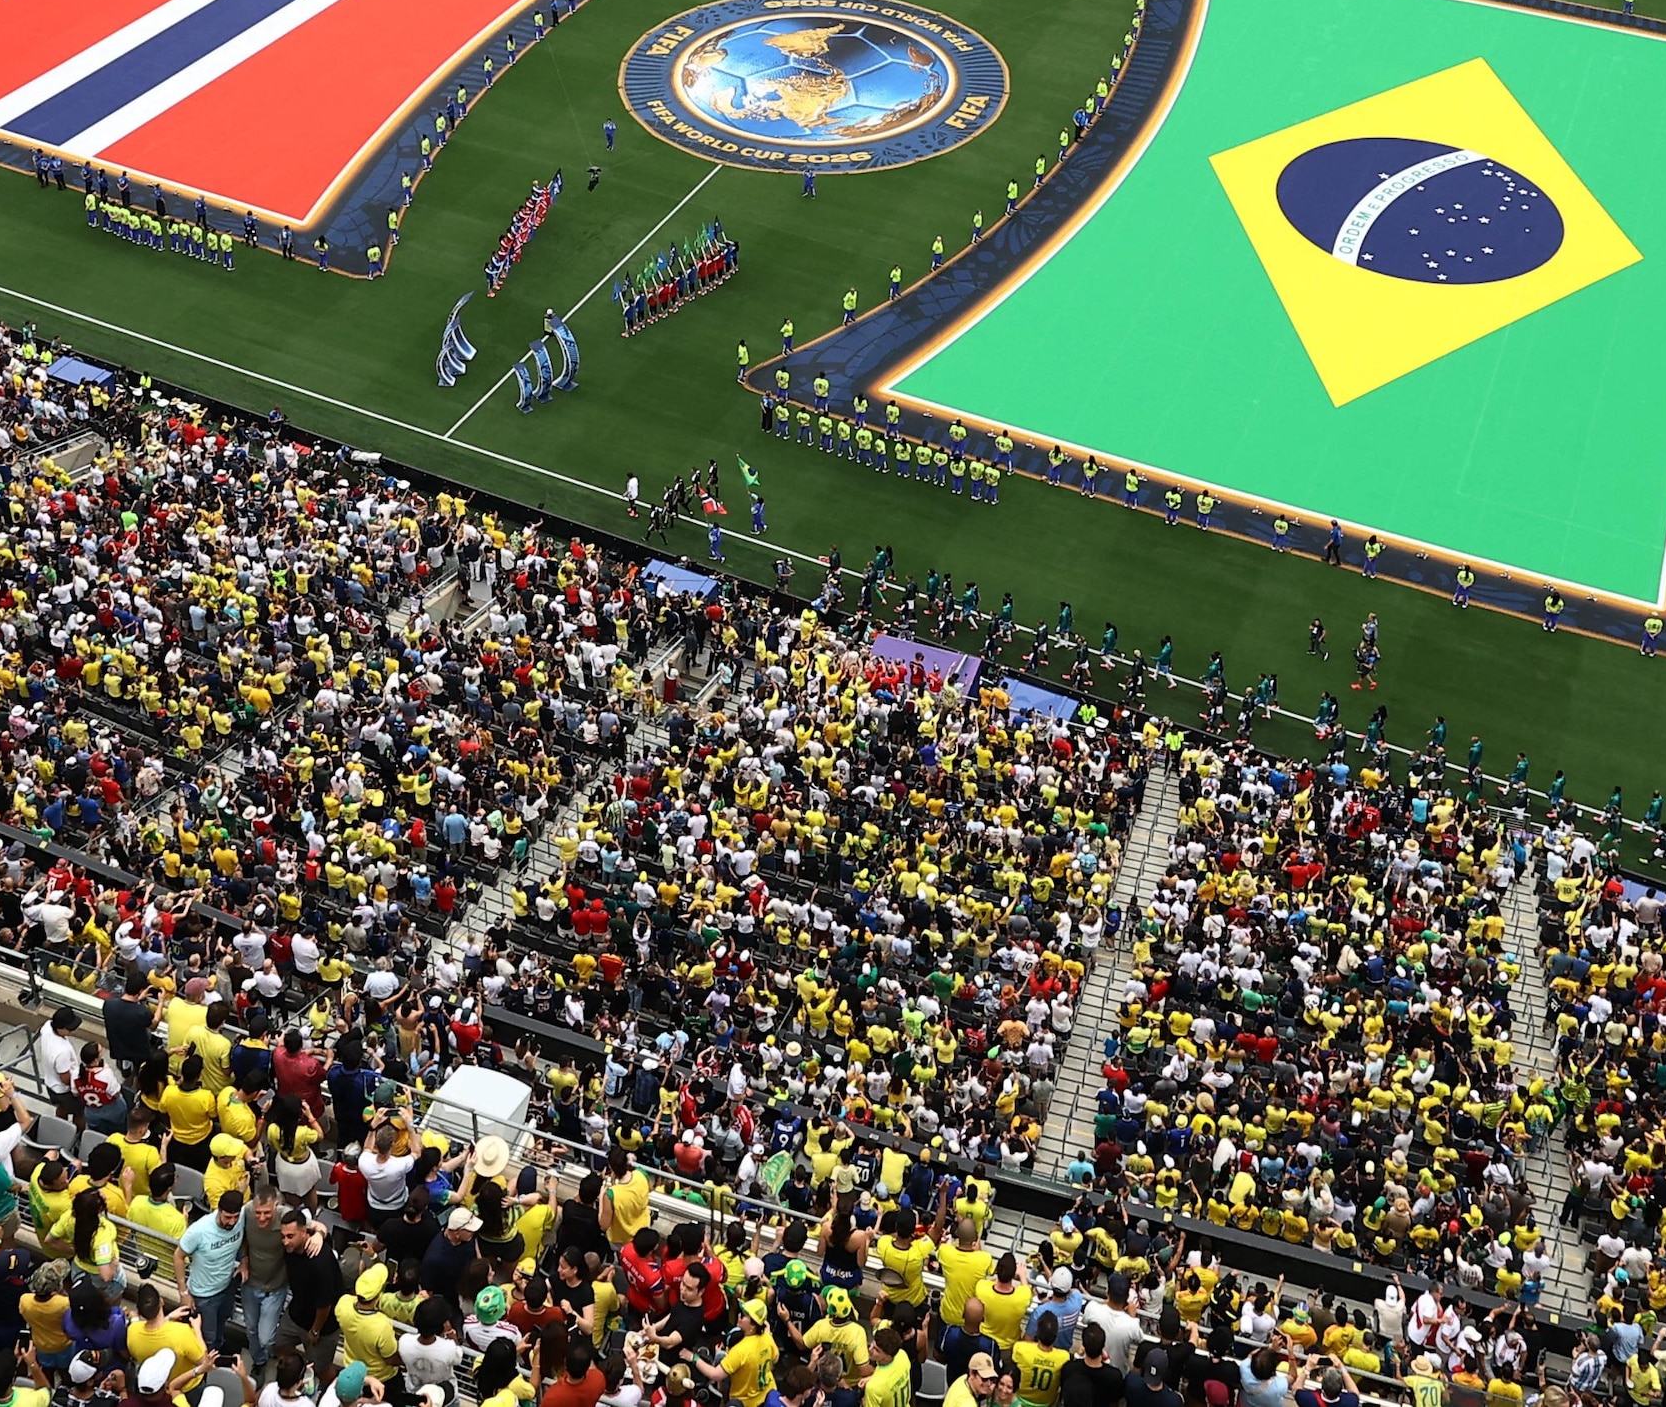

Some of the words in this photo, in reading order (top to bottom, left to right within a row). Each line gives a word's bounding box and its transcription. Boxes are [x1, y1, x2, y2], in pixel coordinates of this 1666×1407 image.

[762, 0, 837, 9] 2026
[839, 1, 879, 12] CUP
[876, 7, 943, 34] WORLD
[645, 24, 695, 58] FIFA
[941, 30, 974, 52] FIFA
[945, 94, 990, 131] FIFA
[646, 100, 677, 125] FIFA
[672, 121, 739, 154] WORLD
[740, 148, 785, 161] CUP
[787, 151, 873, 164] 2026
[1338, 211, 1371, 254] ORDEM
[1368, 202, 1380, 211] E
[1375, 153, 1469, 203] PROGRESSO
[778, 1133, 789, 1148] 9
[211, 1233, 241, 1250] HECHTER
[825, 1264, 853, 1278] BRASIL
[1030, 1366, 1054, 1392] 10
